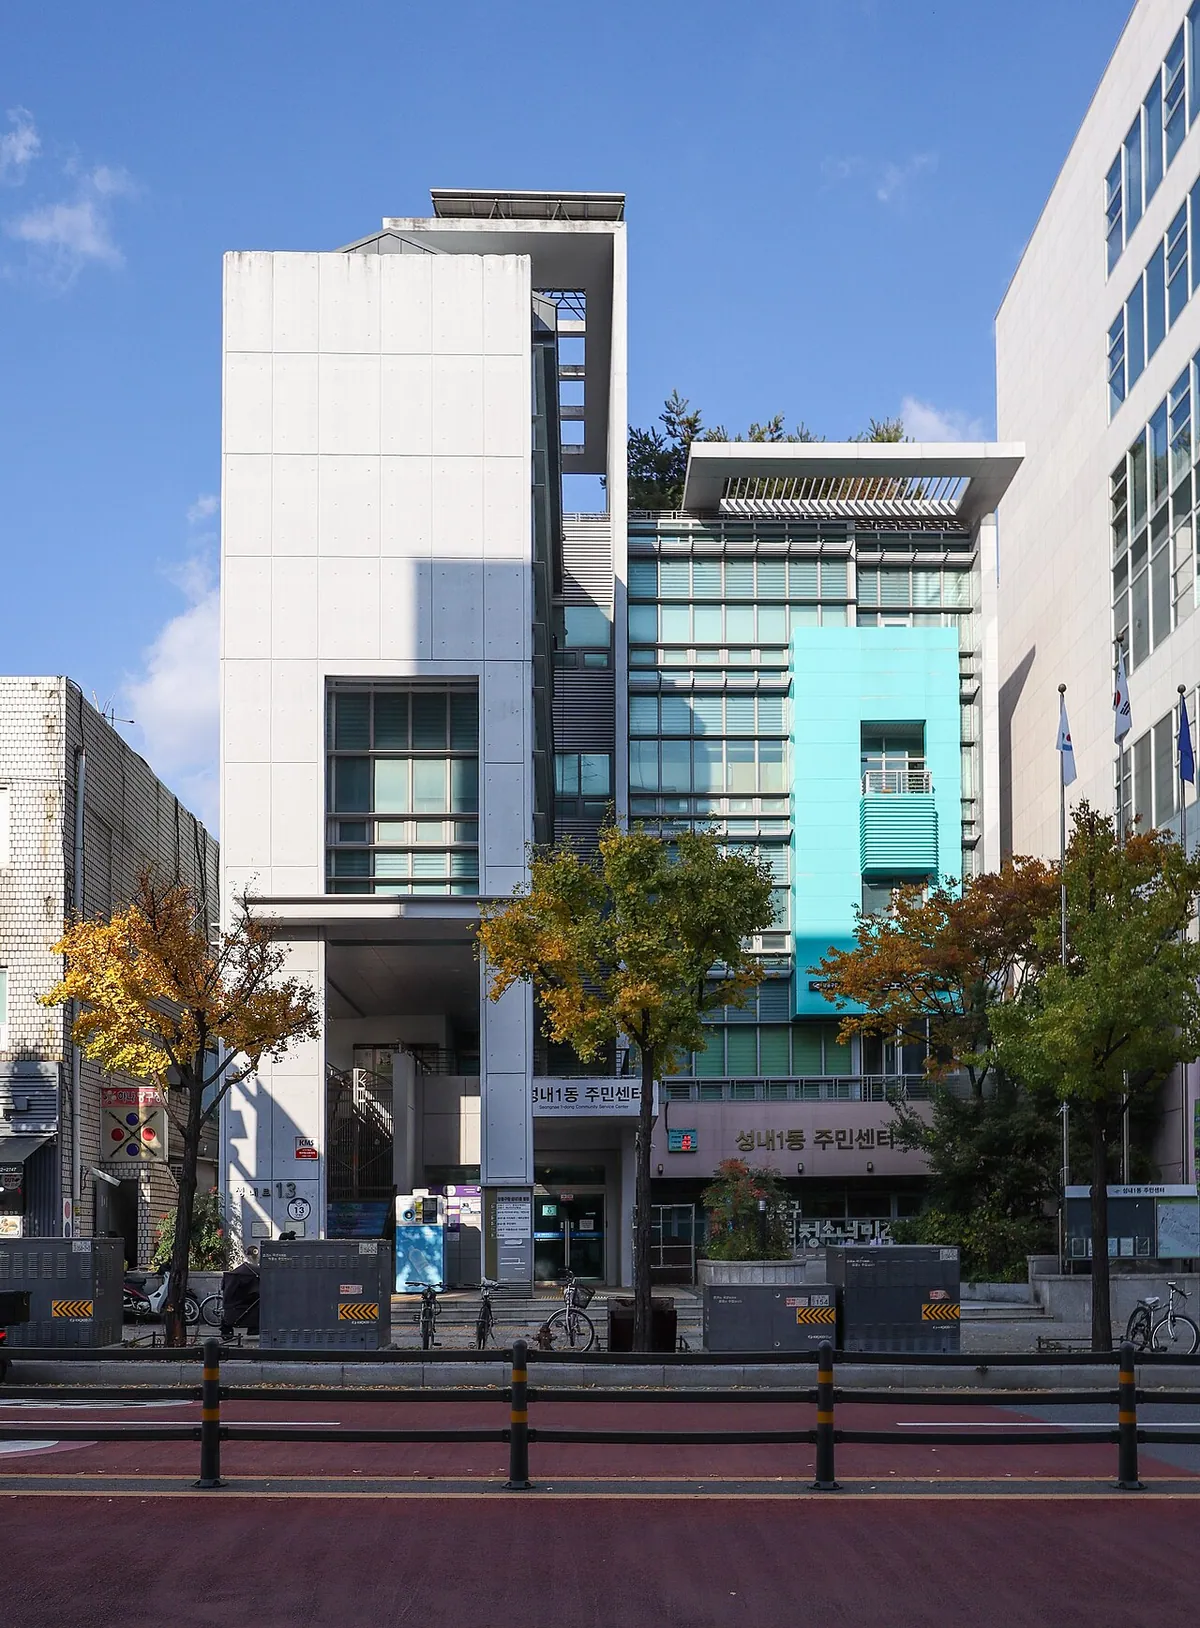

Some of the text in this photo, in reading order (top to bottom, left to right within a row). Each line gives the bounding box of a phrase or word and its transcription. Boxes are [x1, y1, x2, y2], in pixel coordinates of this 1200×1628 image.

[735, 1128, 895, 1151] 성내1동 주민센터
[276, 1182, 296, 1198] 13
